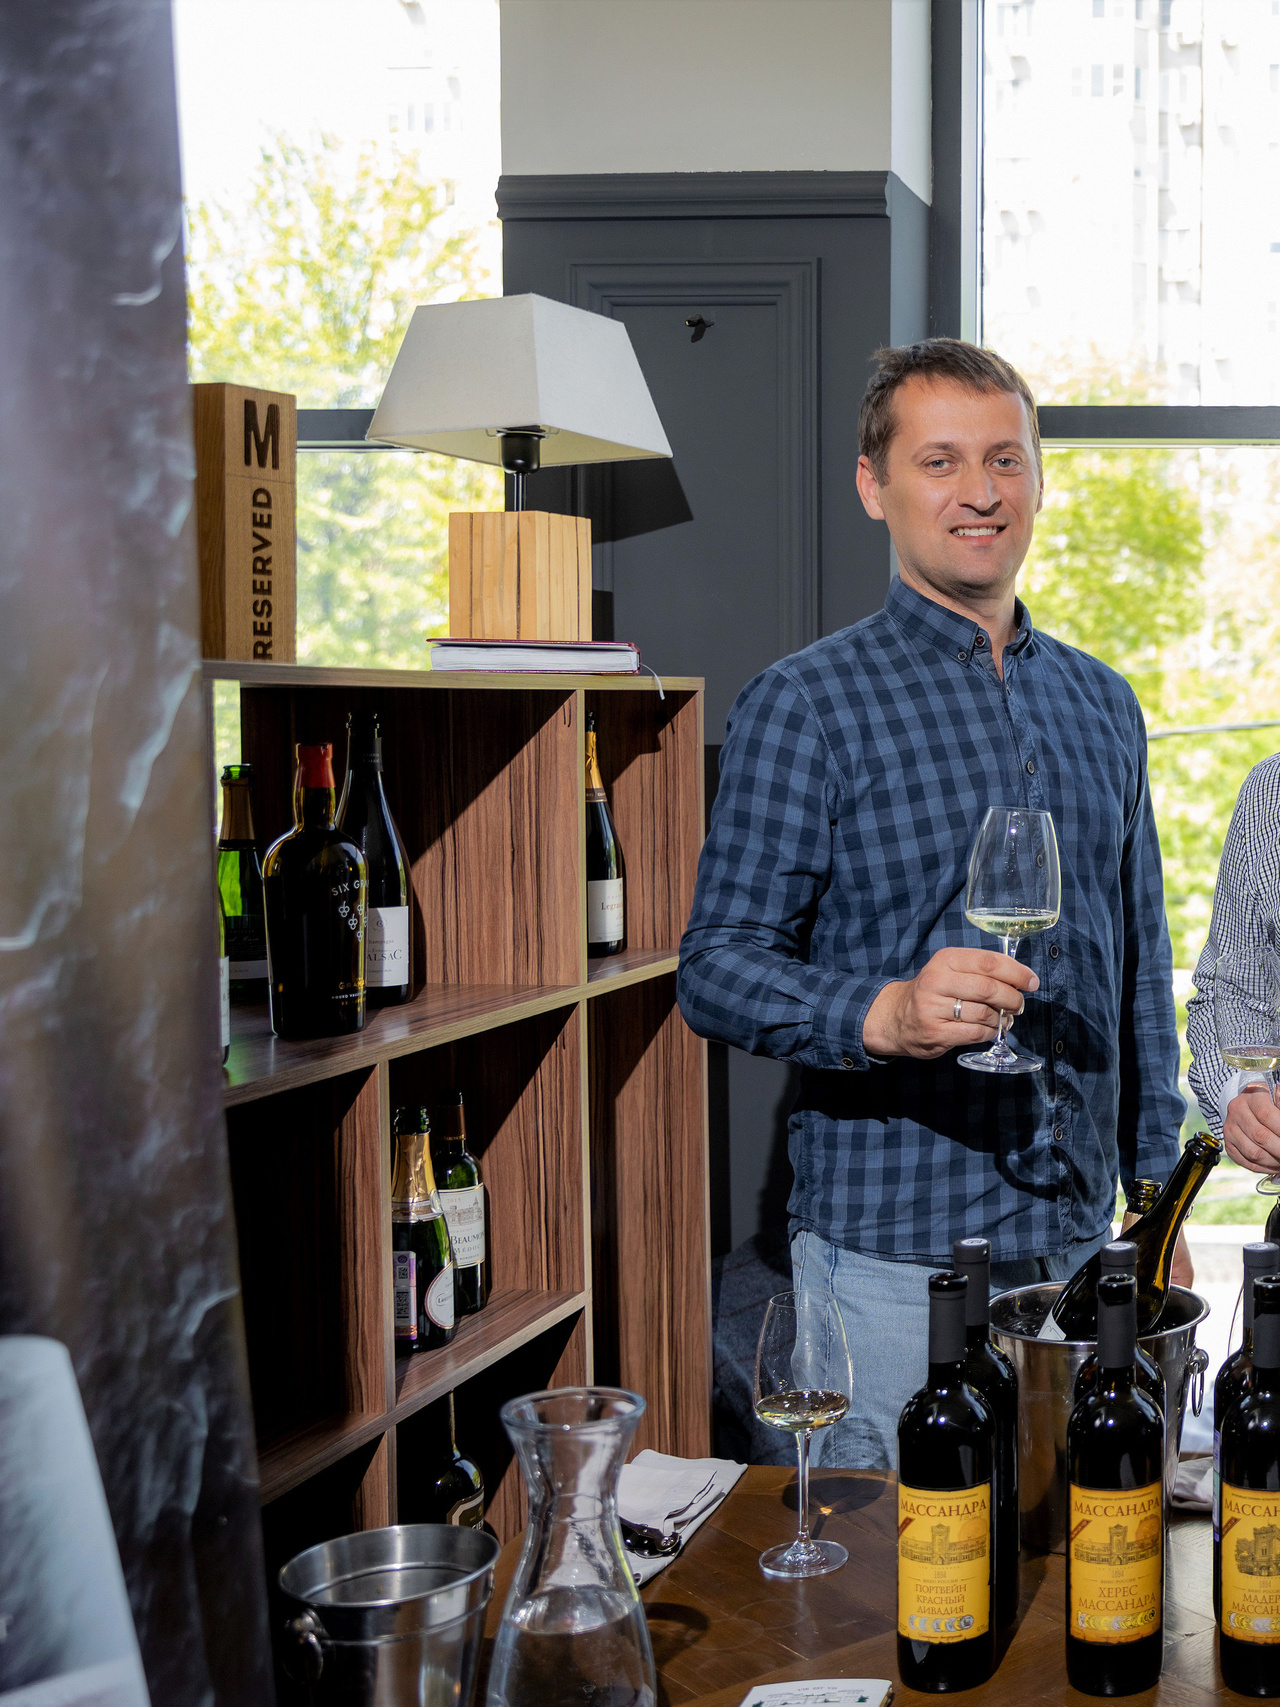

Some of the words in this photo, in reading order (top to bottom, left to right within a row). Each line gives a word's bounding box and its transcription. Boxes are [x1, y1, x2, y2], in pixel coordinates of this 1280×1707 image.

[244, 399, 280, 470] M
[252, 487, 273, 661] RESERVED
[331, 882, 350, 896] SIX
[367, 949, 402, 961] ALSAC
[900, 1498, 988, 1518] МАССАНДРА
[1073, 1495, 1161, 1518] МАССАНДРА
[915, 1583, 968, 1594] ПОРТВЕЙН
[1098, 1584, 1138, 1598] ХЕРЕС
[916, 1593, 965, 1605] КРАСНЫЙ
[1078, 1592, 1156, 1612] МАССАНДРА
[917, 1604, 965, 1616] ЛИВАДИЯ
